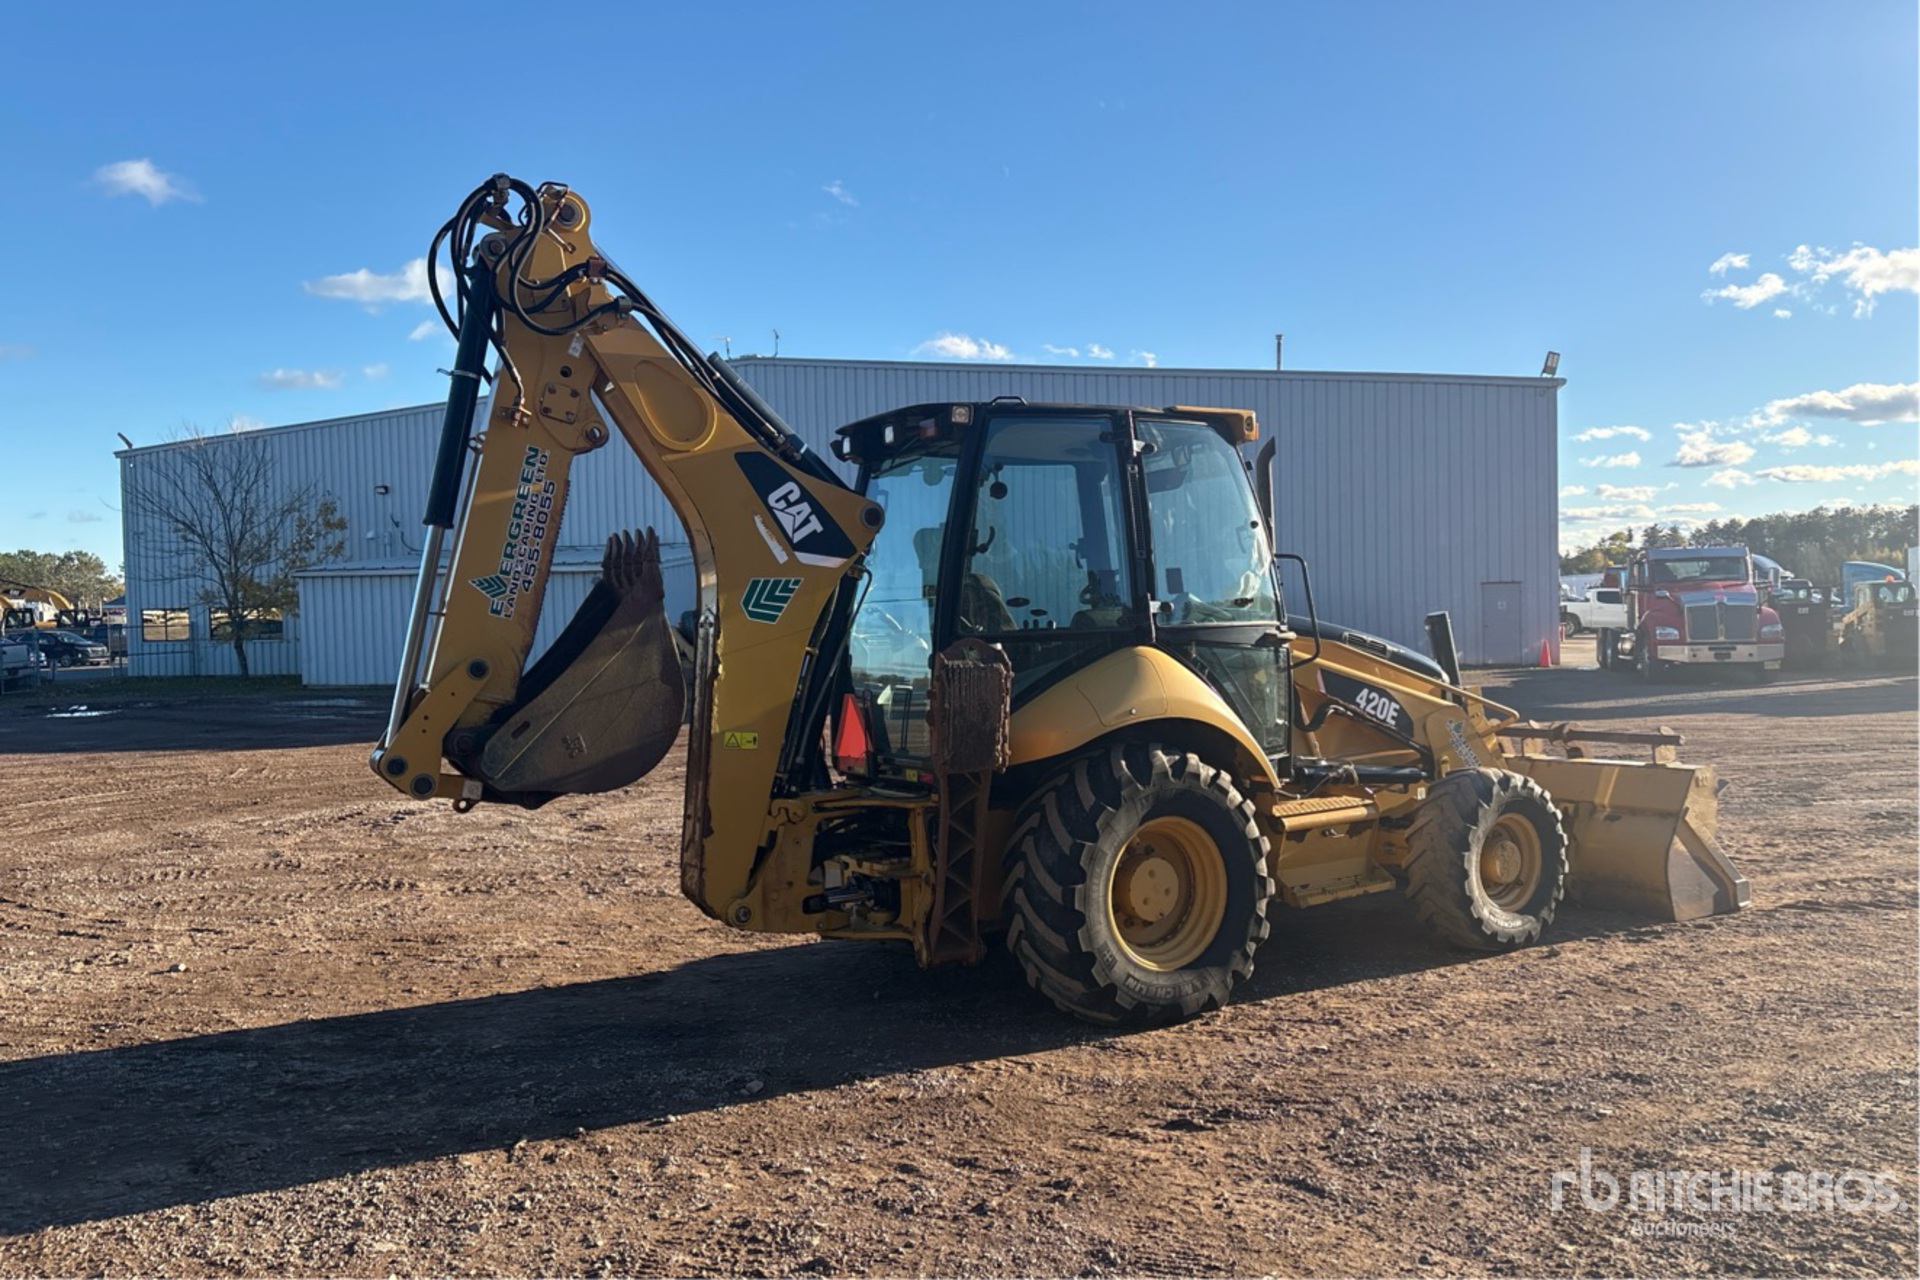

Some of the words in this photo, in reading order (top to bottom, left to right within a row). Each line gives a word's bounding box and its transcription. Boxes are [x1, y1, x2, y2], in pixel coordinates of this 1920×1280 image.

[470, 446, 540, 617] EVERGREEN
[504, 492, 540, 618] LANDSCAPING
[520, 480, 556, 593] 455-8055
[767, 481, 824, 544] CAT
[1355, 687, 1400, 727] 420E
[1124, 977, 1194, 1000] MICHELIN
